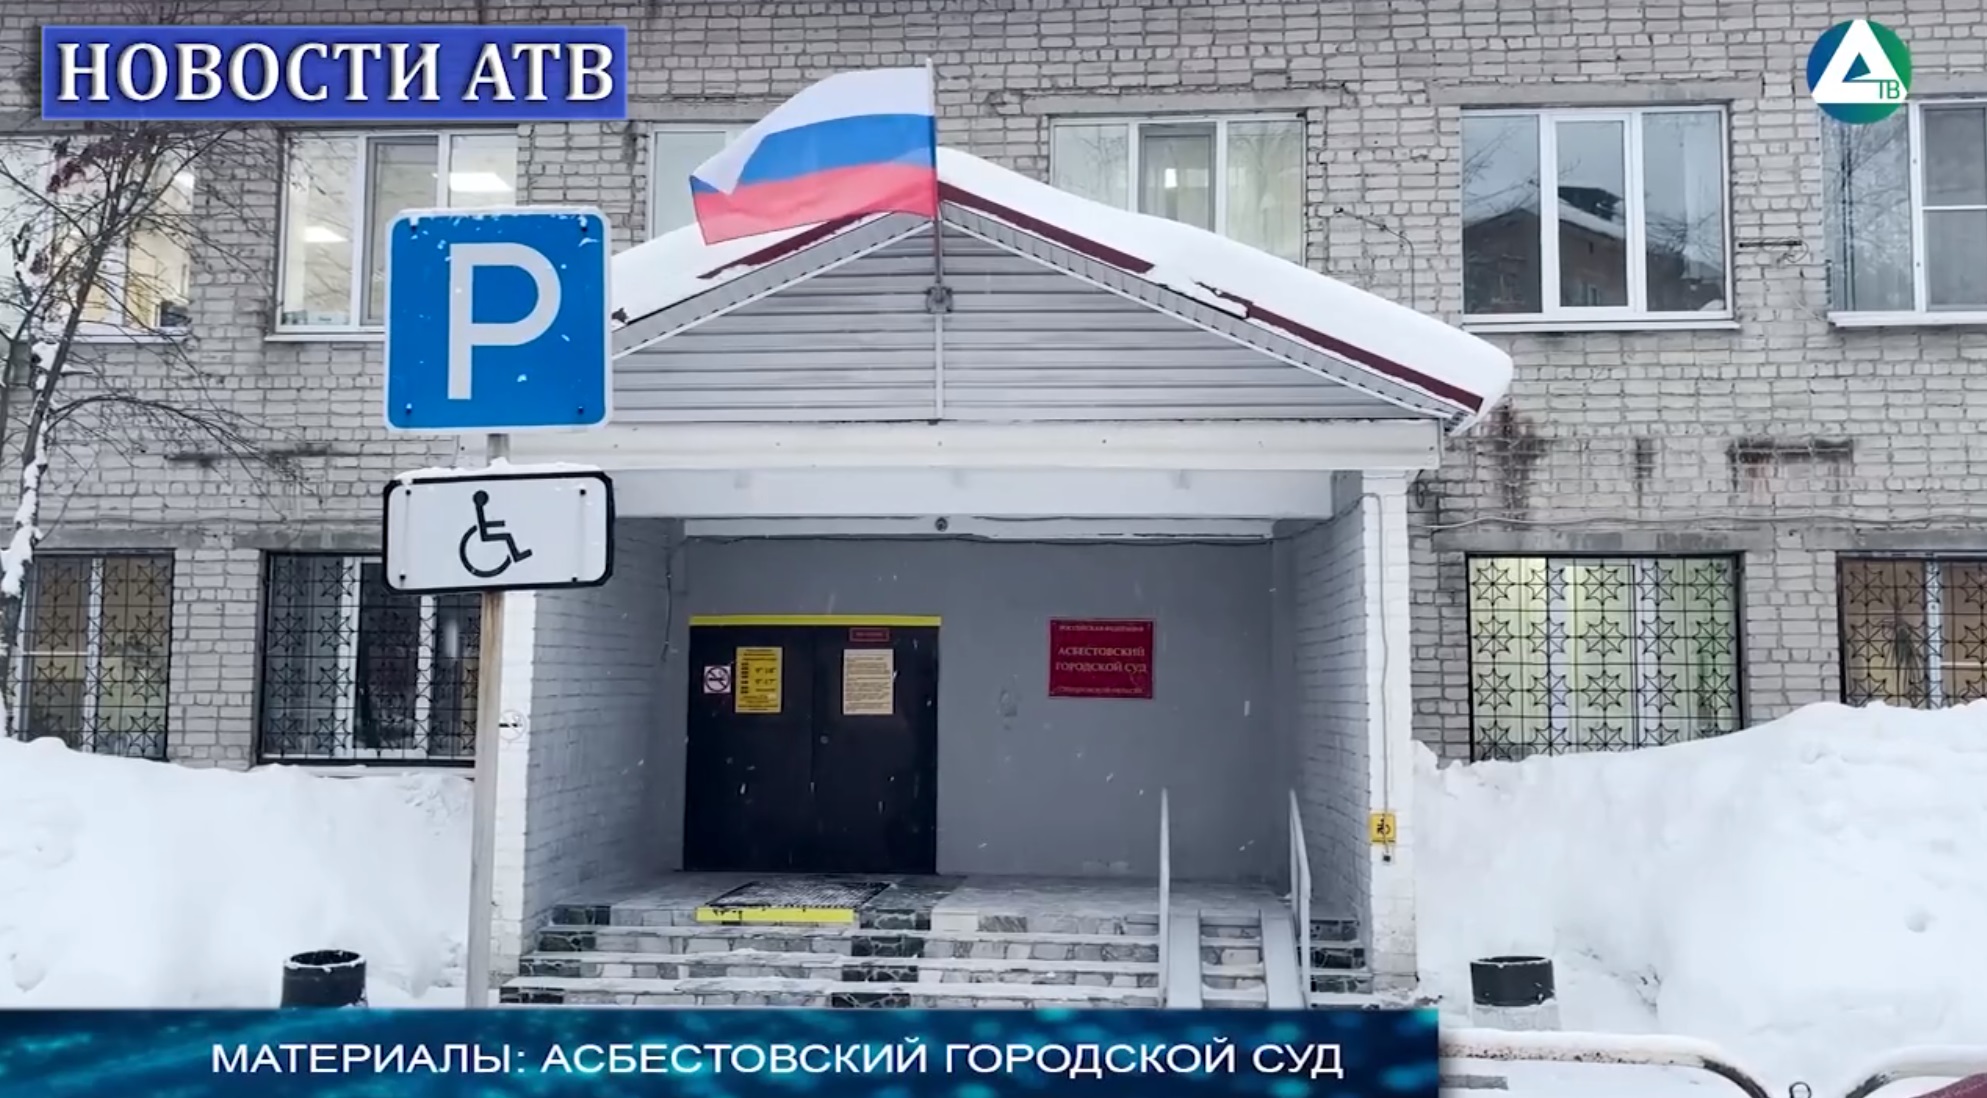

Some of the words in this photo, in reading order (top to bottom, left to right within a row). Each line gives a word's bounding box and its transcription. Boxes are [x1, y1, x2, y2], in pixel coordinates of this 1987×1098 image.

[447, 242, 562, 400] P
[1057, 646, 1146, 657] АСБЕСТОВСКИЙ
[1055, 660, 1122, 673] ГОРОДСКОЙ
[1124, 662, 1148, 674] СУД
